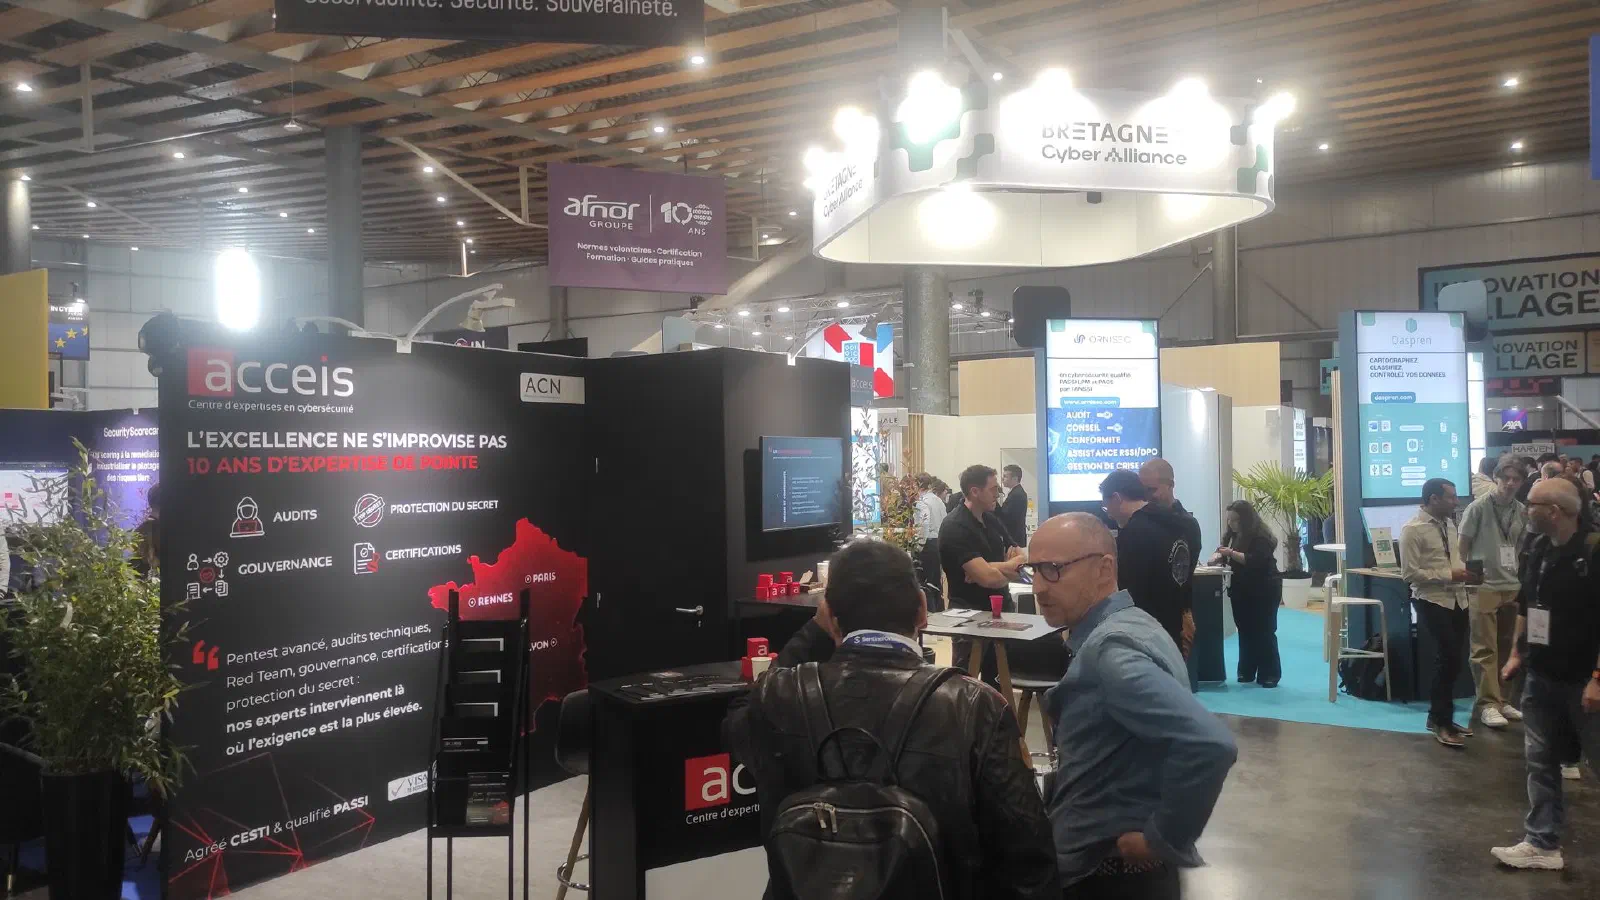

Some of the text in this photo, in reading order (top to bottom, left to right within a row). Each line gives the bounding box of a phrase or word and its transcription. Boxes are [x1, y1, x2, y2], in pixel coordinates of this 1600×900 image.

[1042, 121, 1169, 144] BRETAGNE
[1041, 144, 1188, 165] Cyber Alliance
[563, 194, 641, 221] afnor
[589, 220, 634, 231] GROUPE
[688, 227, 706, 236] ANS
[577, 243, 703, 258] Normes volontaires Certification
[586, 252, 694, 267] Formation Guides pratiques
[1434, 269, 1600, 298] IOVATION
[1487, 289, 1600, 321] LAGE
[1391, 336, 1432, 348] Daspren
[205, 355, 355, 397] acceis
[525, 377, 561, 395] ACN
[1374, 394, 1413, 403] daspren.com
[188, 399, 354, 414] Centre d'expertises en cybersécurité
[1065, 411, 1091, 419] AUDIT
[1065, 423, 1101, 432] CONSEIL
[1501, 420, 1523, 430] AXA
[187, 431, 508, 449] L'EXCELLENCE NE S'IMPROVISE PAS
[1067, 448, 1118, 458] ASSISTANCE
[187, 455, 479, 474] 10 ANS D'EXPERTISE DE POINTE
[1067, 462, 1103, 470] GESTION
[1104, 462, 1115, 470] DE
[1116, 461, 1139, 470] CRISE
[390, 500, 499, 514] PROTECTION DU SECRET
[273, 509, 318, 523] AUDITS
[385, 544, 462, 561] CERTIFICATIONS
[238, 556, 333, 576] GOUVERNANCE
[532, 572, 557, 583] PARIS
[478, 592, 514, 607] RENNES
[226, 622, 432, 666] Pentest avancé, audits techniques,
[529, 640, 549, 652] YON
[226, 673, 254, 689] Red
[256, 666, 296, 684] Team,
[298, 651, 379, 677] gouvernance,
[226, 675, 355, 713] protection du secret
[226, 684, 405, 734] nos experts interviennent là
[226, 701, 423, 756] où l'exigence est la plus élevée.
[686, 811, 718, 825] Centre
[184, 796, 369, 863] Agréé CESTI & qualifié PASSI
